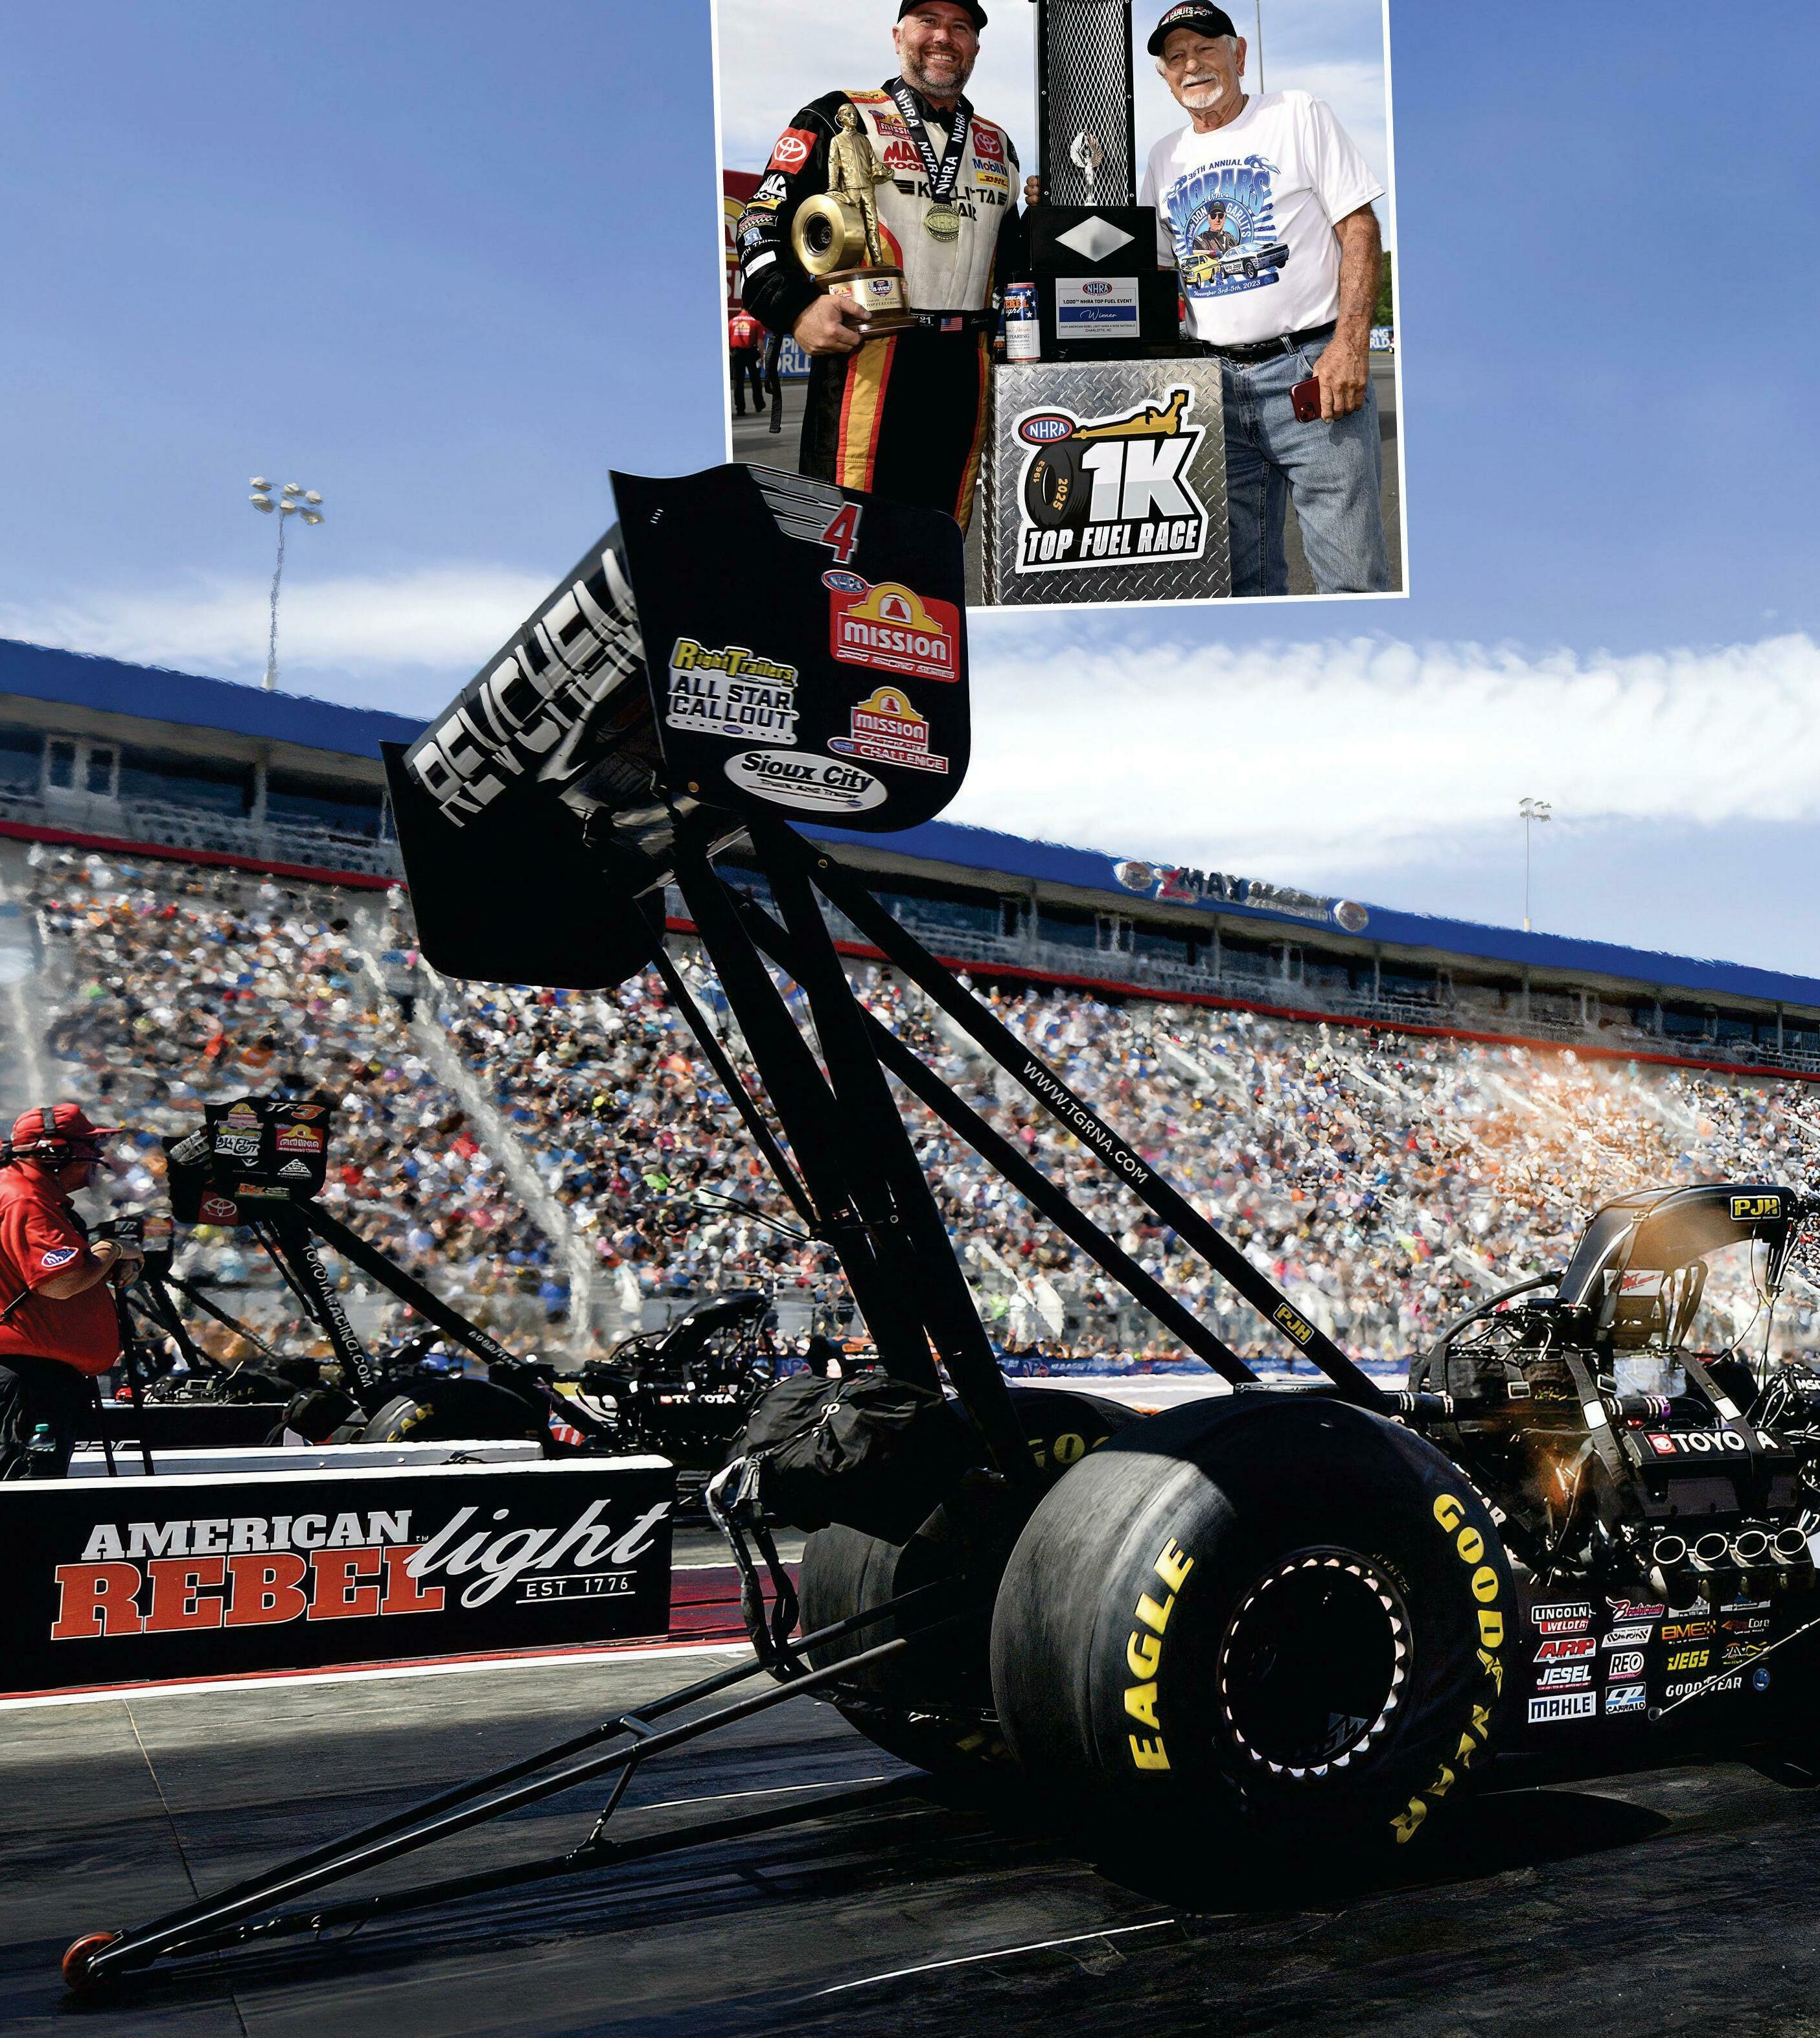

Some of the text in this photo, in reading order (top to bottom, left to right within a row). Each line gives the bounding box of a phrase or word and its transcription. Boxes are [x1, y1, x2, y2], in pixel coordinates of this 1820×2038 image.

[895, 89, 919, 127] NHRA
[881, 122, 911, 135] MISSI
[951, 111, 965, 143] NHRA
[886, 163, 927, 173] TOOL
[918, 141, 938, 185] NHRA
[936, 156, 958, 194] NHRA
[973, 158, 999, 174] Mobil
[1188, 159, 1242, 180] 36TH ANNUAL
[984, 175, 1008, 187] DHL
[1168, 168, 1271, 227] MOPARS
[1192, 206, 1208, 225] DON
[1226, 203, 1251, 238] GARLITS
[1087, 284, 1109, 293] NHRA
[1243, 280, 1261, 290] 2023
[1005, 299, 1029, 308] EBEL
[1079, 308, 1117, 321] Winner
[1030, 421, 1066, 439] NHRA
[1033, 460, 1046, 483] 1963
[1081, 438, 1194, 521] 1K
[1052, 478, 1068, 510] 2025
[821, 501, 863, 564] 4
[1027, 520, 1198, 562] TOP FUEL RACE
[844, 621, 947, 661] MISSION
[674, 676, 790, 711] ALL STAR
[674, 696, 788, 730] CALLOUT
[855, 714, 924, 740] MISSION
[741, 752, 818, 781] Sioux
[822, 766, 875, 793] City
[1023, 1061, 1149, 1185] WWW.TGRNA.COM
[1734, 1198, 1778, 1217] PJH
[1276, 1306, 1311, 1342] PJH
[1670, 1430, 1779, 1454] TOYOA
[81, 1510, 412, 1561] AMERICAN
[403, 1499, 673, 1609] light
[51, 1544, 445, 1640] REBEL
[526, 1577, 628, 1597] EST 1776
[1535, 1607, 1587, 1620] LINCOLN
[1662, 1622, 1706, 1640] BME
[1125, 1537, 1195, 1770] EAGLE
[1538, 1640, 1595, 1659] ARP
[1667, 1649, 1710, 1671] JEGS
[1536, 1665, 1592, 1686] JESEL
[1611, 1653, 1643, 1674] REO
[1666, 1675, 1742, 1697] GOODEAR
[1532, 1696, 1591, 1719] MAHLE
